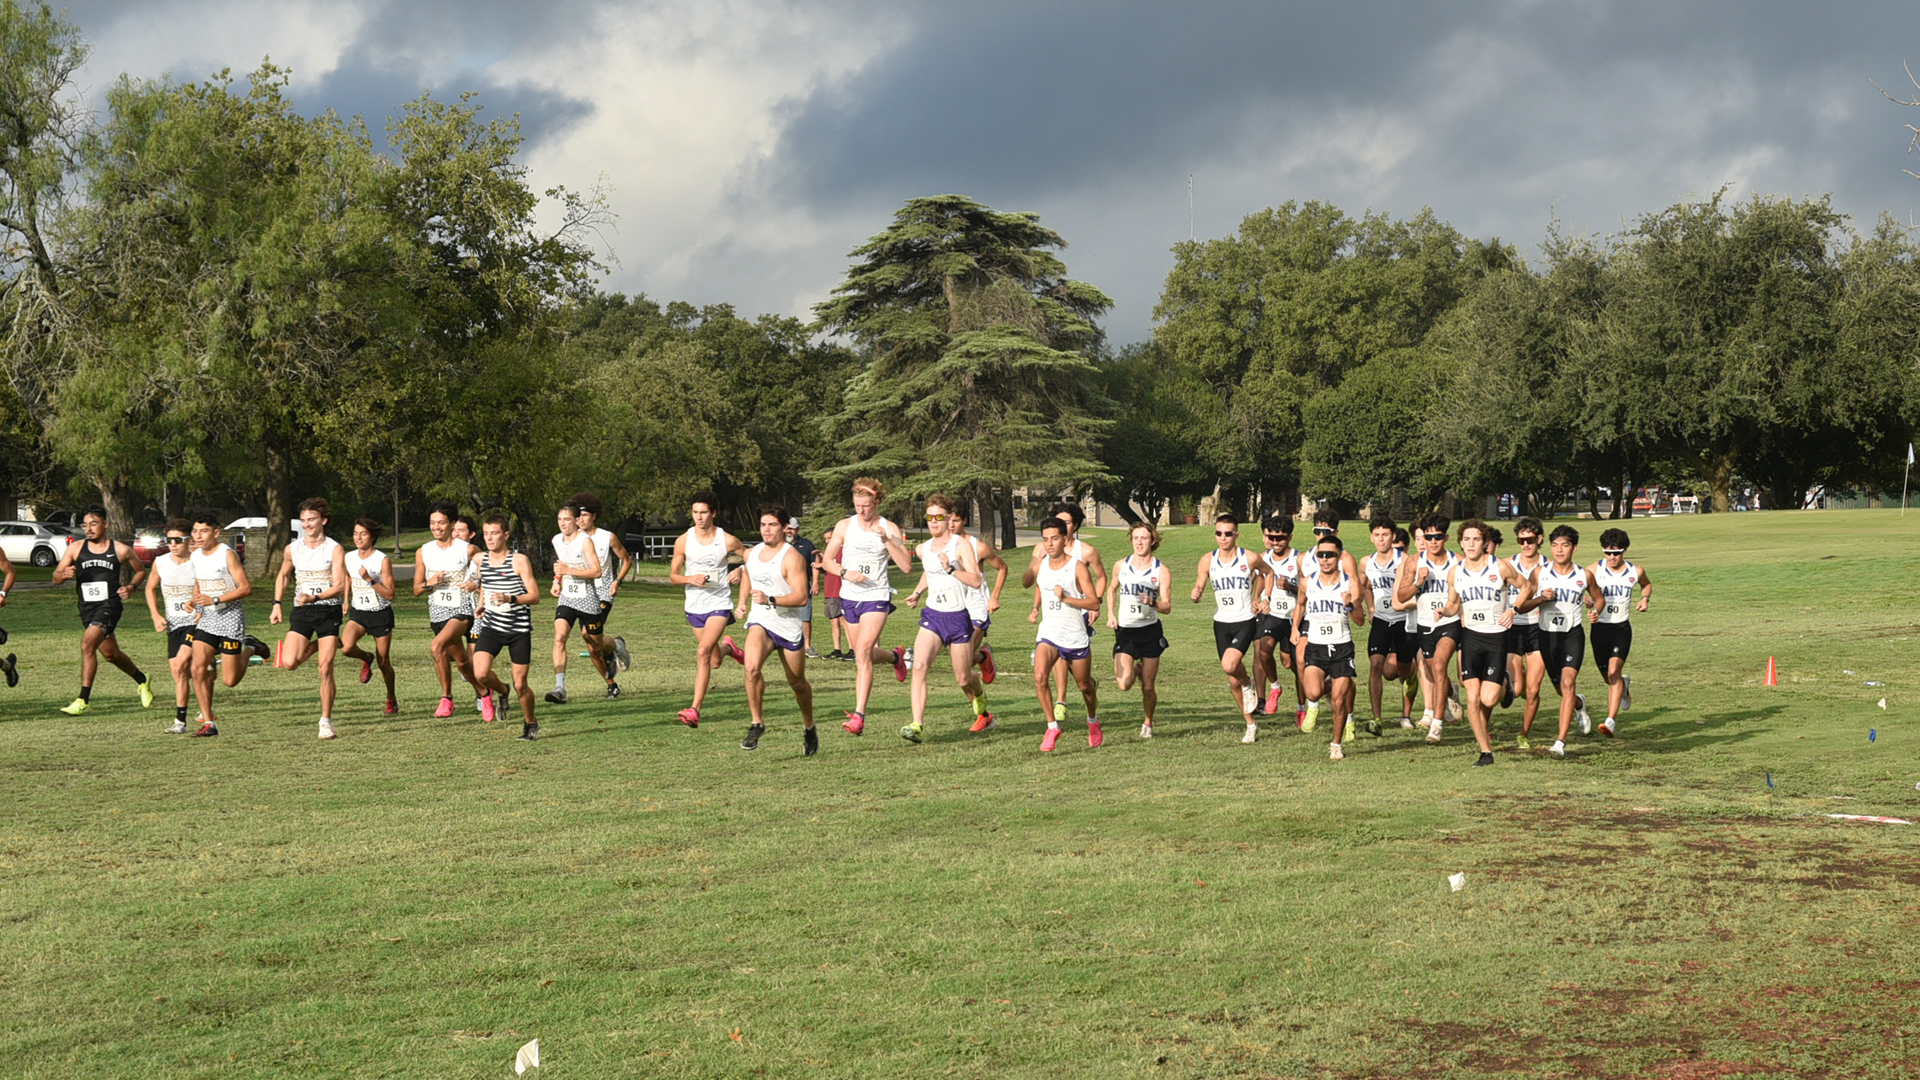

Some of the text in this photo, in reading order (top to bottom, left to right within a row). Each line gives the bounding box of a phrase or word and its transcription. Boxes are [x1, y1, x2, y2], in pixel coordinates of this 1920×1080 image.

[81, 559, 114, 571] VICTORIA
[858, 565, 870, 574] 38
[88, 587, 100, 596] 85
[568, 585, 578, 593] 82
[441, 592, 452, 601] 76
[936, 594, 947, 603] 41
[1049, 600, 1061, 610] 39
[1222, 597, 1234, 606] 53
[1276, 602, 1288, 610] 58
[1430, 601, 1443, 611] 50
[1130, 605, 1142, 613] 51
[1607, 606, 1619, 614] 60
[1472, 613, 1485, 621] 49
[1552, 617, 1564, 626] 47
[1320, 626, 1333, 635] 59
[223, 641, 239, 650] TLU
